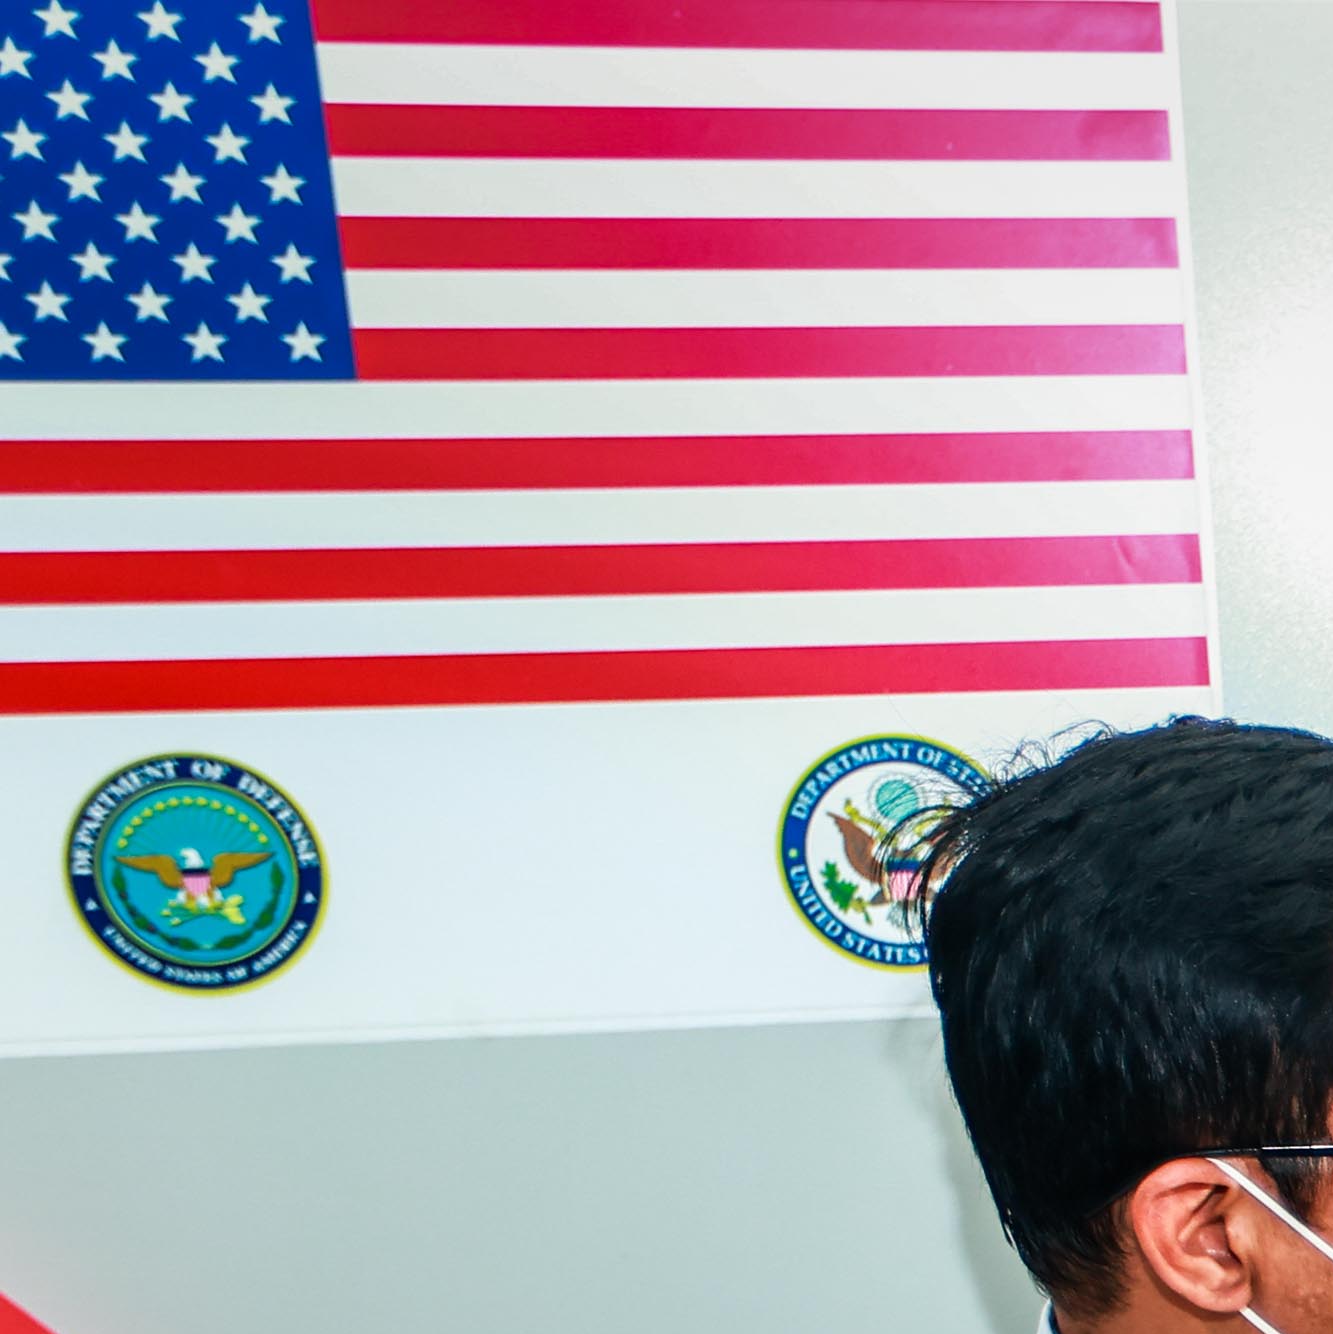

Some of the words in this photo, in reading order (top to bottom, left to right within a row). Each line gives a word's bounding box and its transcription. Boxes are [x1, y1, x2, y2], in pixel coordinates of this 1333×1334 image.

[71, 759, 179, 875] DEPARTMENT
[190, 759, 231, 782] OF
[237, 772, 320, 868] DEFENSE
[790, 742, 915, 820] DEPARTMENT
[916, 745, 946, 768] OF
[788, 865, 842, 938] UNITED
[841, 929, 922, 963] STATES
